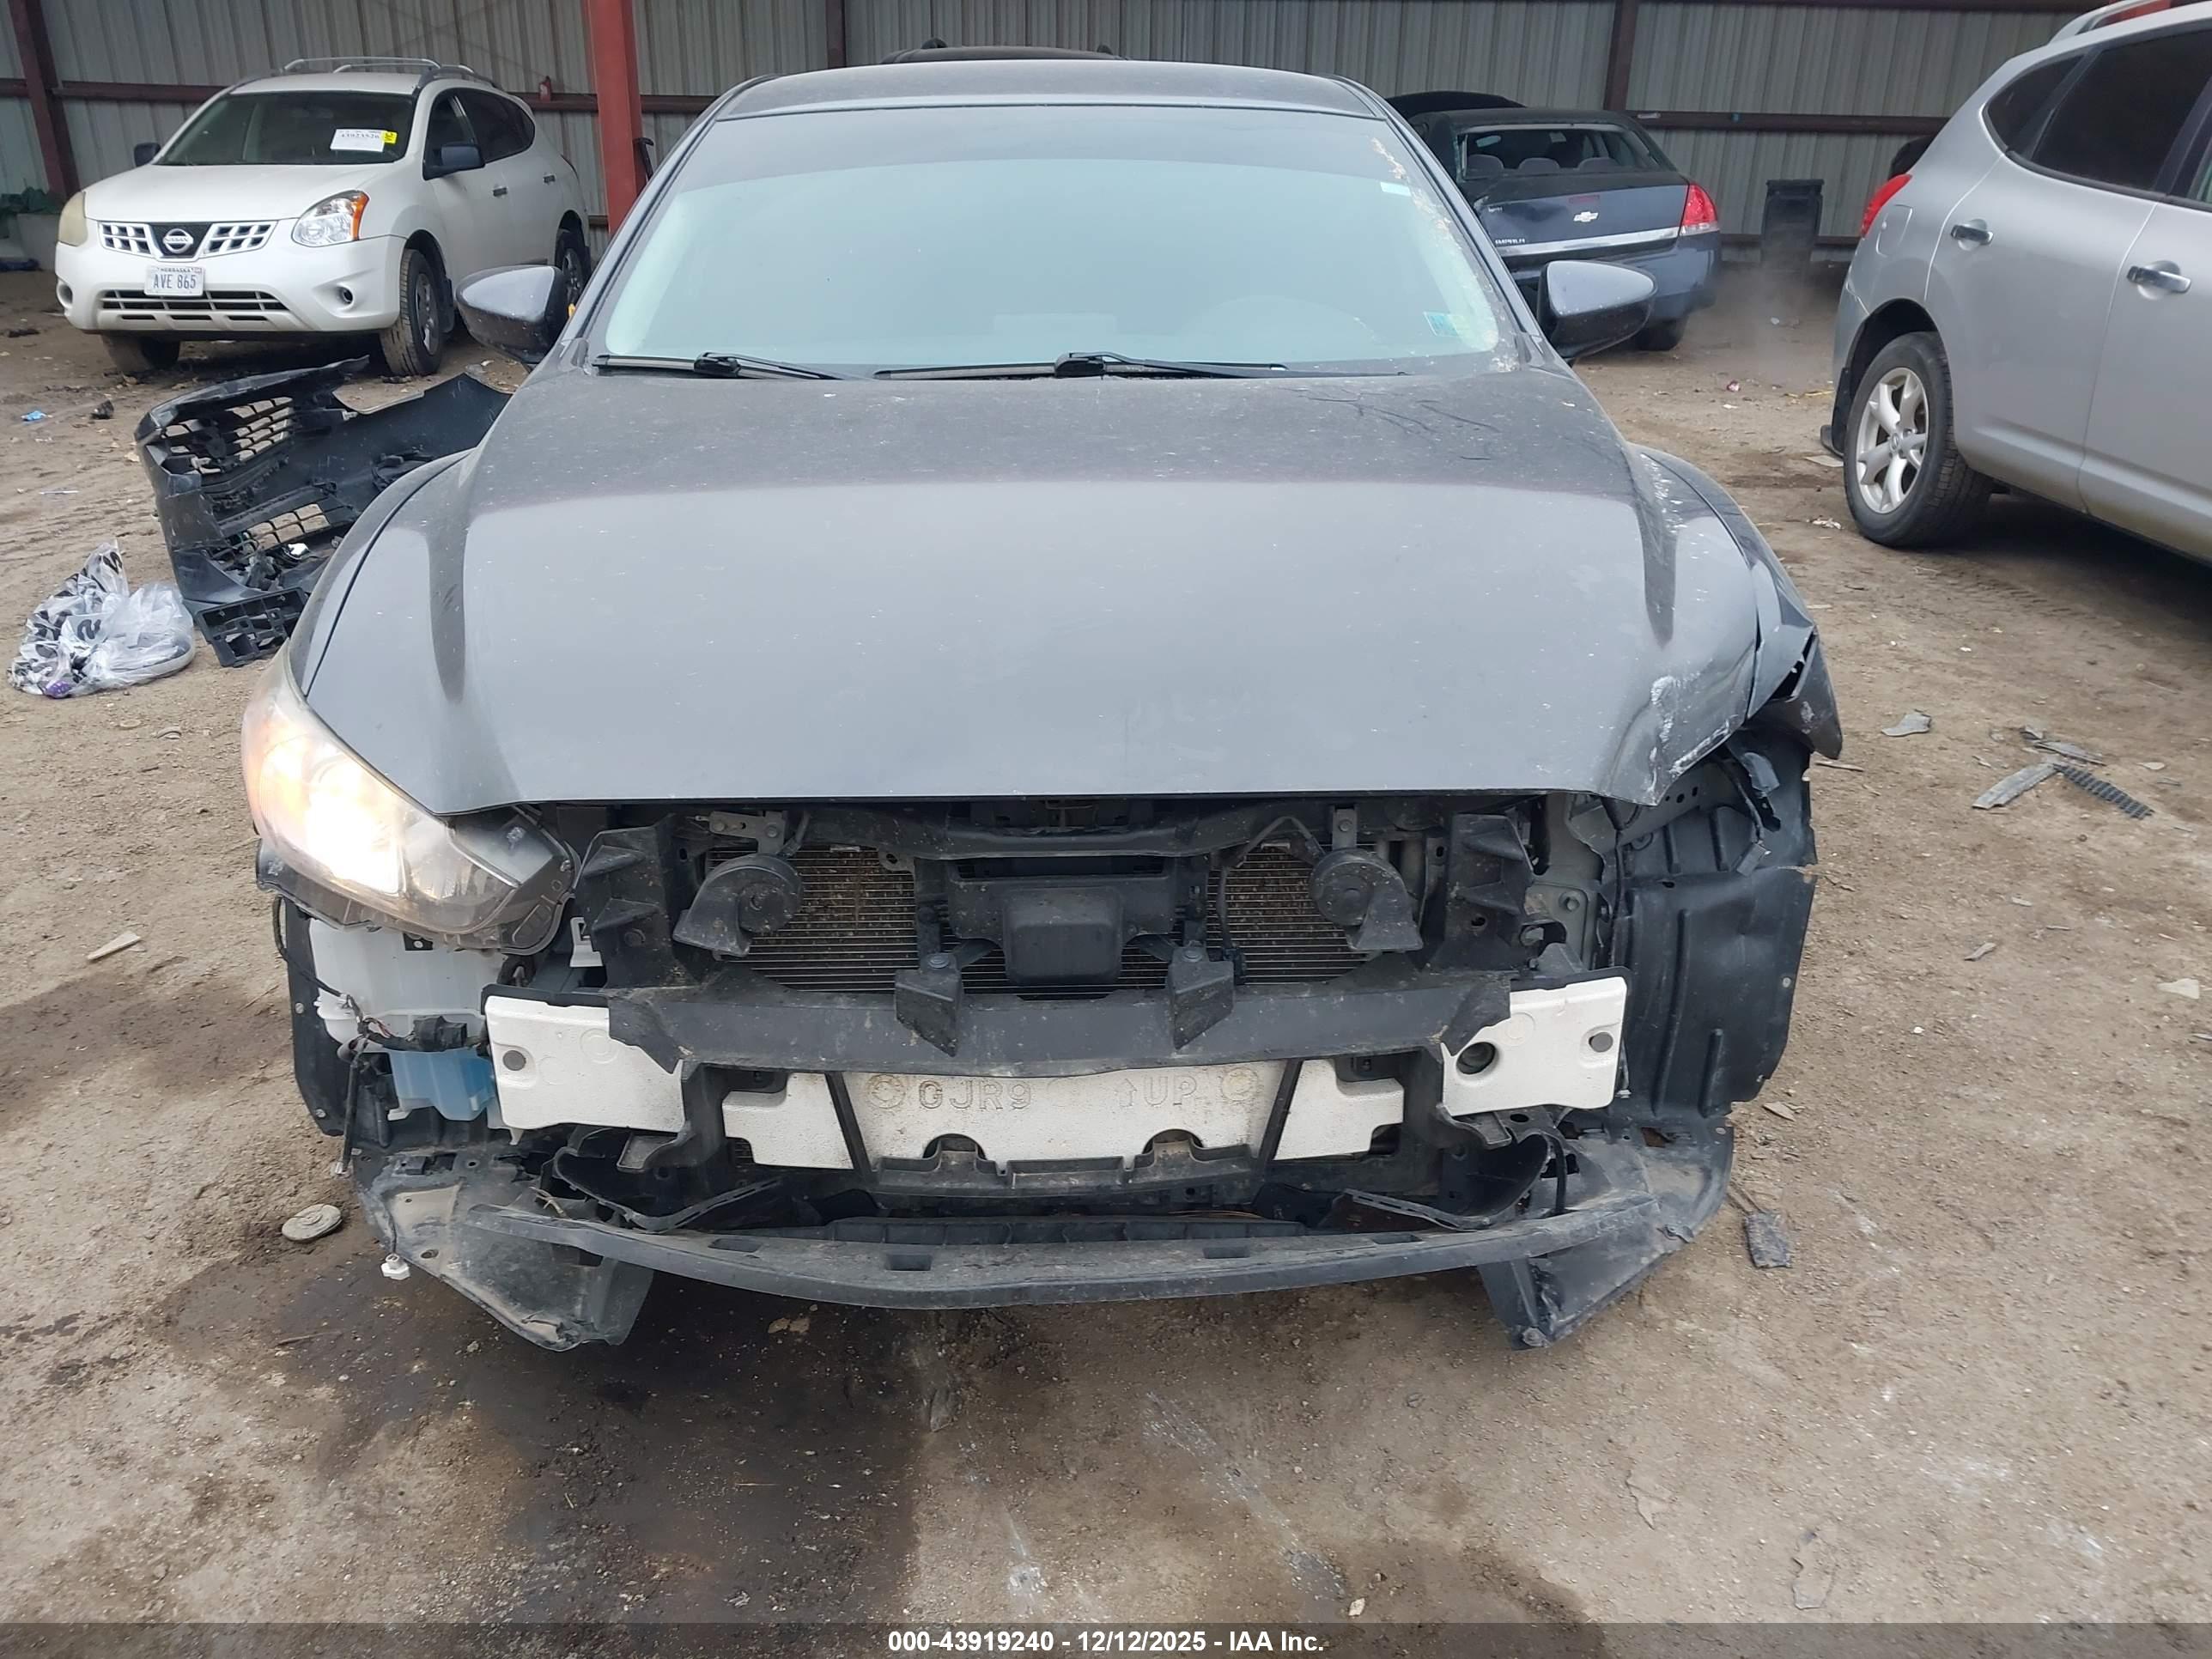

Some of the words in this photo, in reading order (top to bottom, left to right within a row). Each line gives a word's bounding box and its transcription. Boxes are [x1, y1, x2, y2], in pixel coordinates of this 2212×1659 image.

[153, 274, 173, 289] AVE
[177, 274, 197, 289] 865
[919, 1079, 1030, 1109] GJR9
[1144, 1075, 1197, 1107] UP
